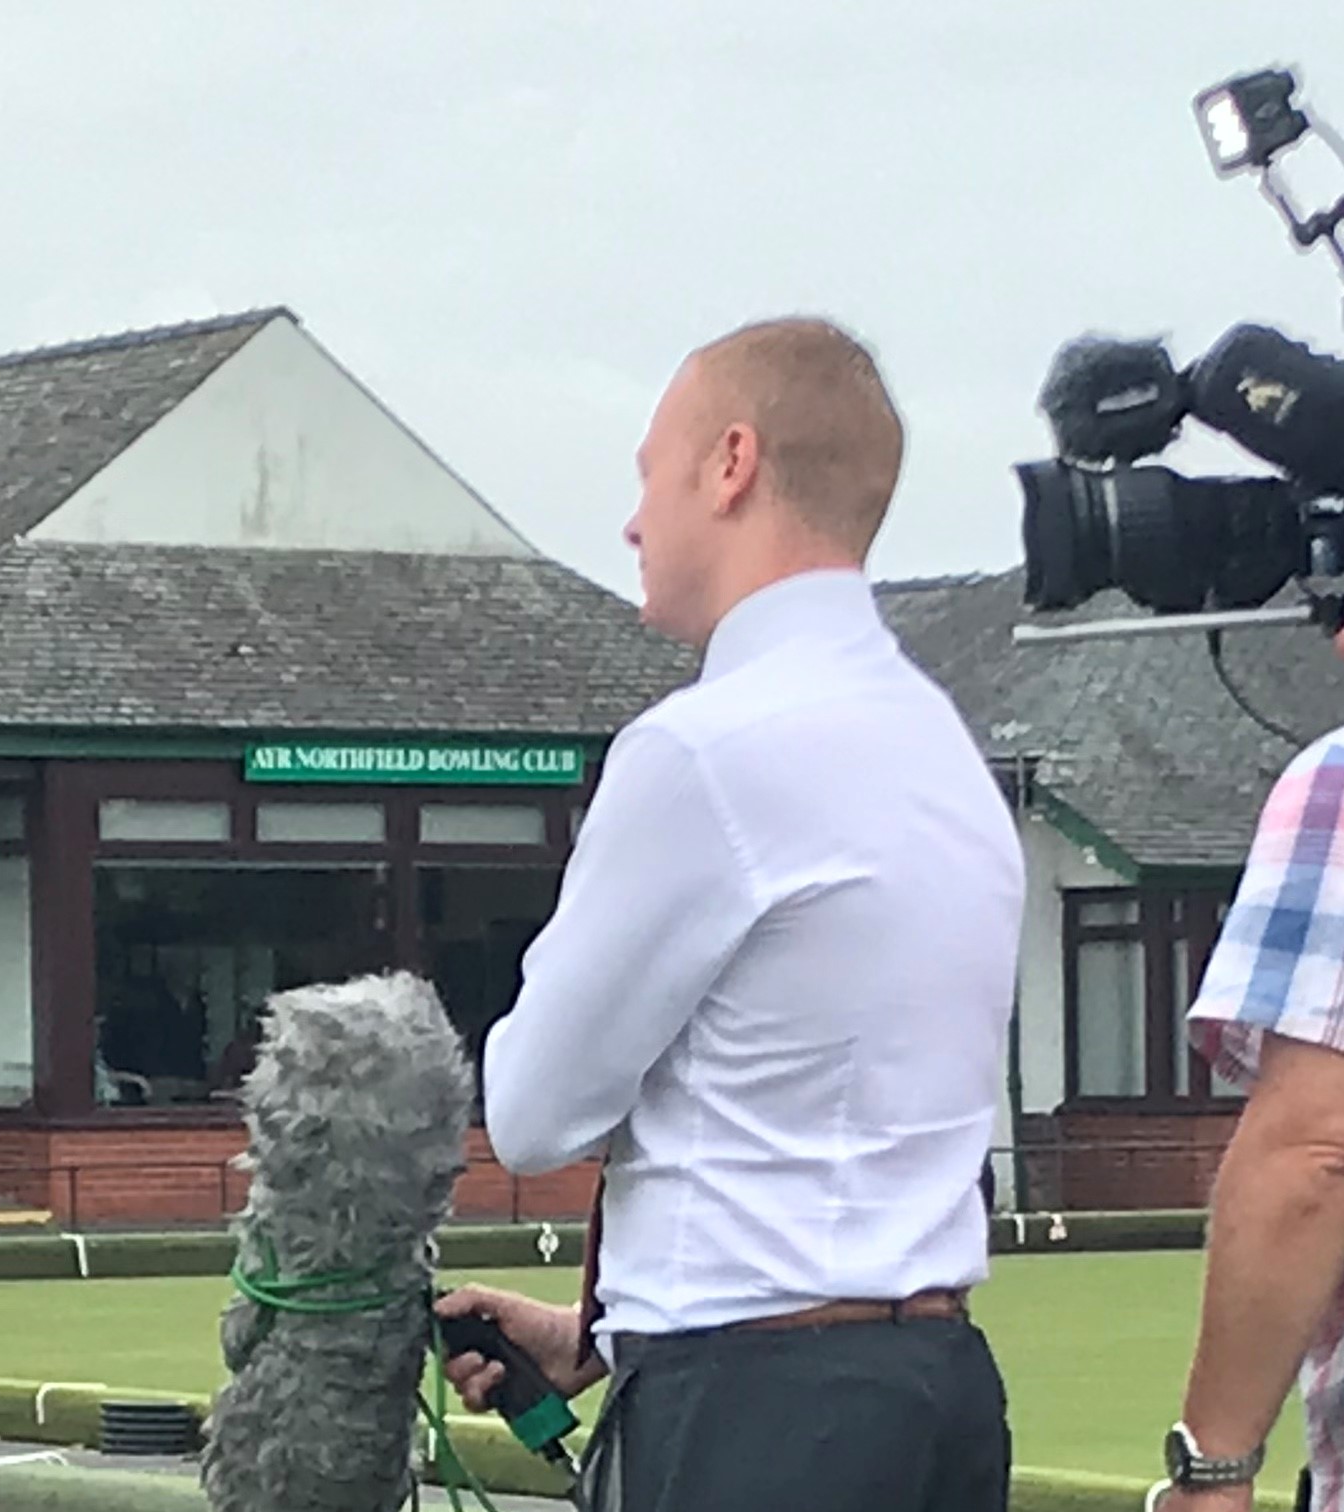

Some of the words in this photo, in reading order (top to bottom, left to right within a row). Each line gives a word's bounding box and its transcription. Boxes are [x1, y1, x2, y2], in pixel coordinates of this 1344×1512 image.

[252, 747, 292, 769] AYR
[295, 747, 425, 771] NORTHFIELD
[427, 748, 520, 771] BOWLING
[522, 749, 576, 773] CLUB
